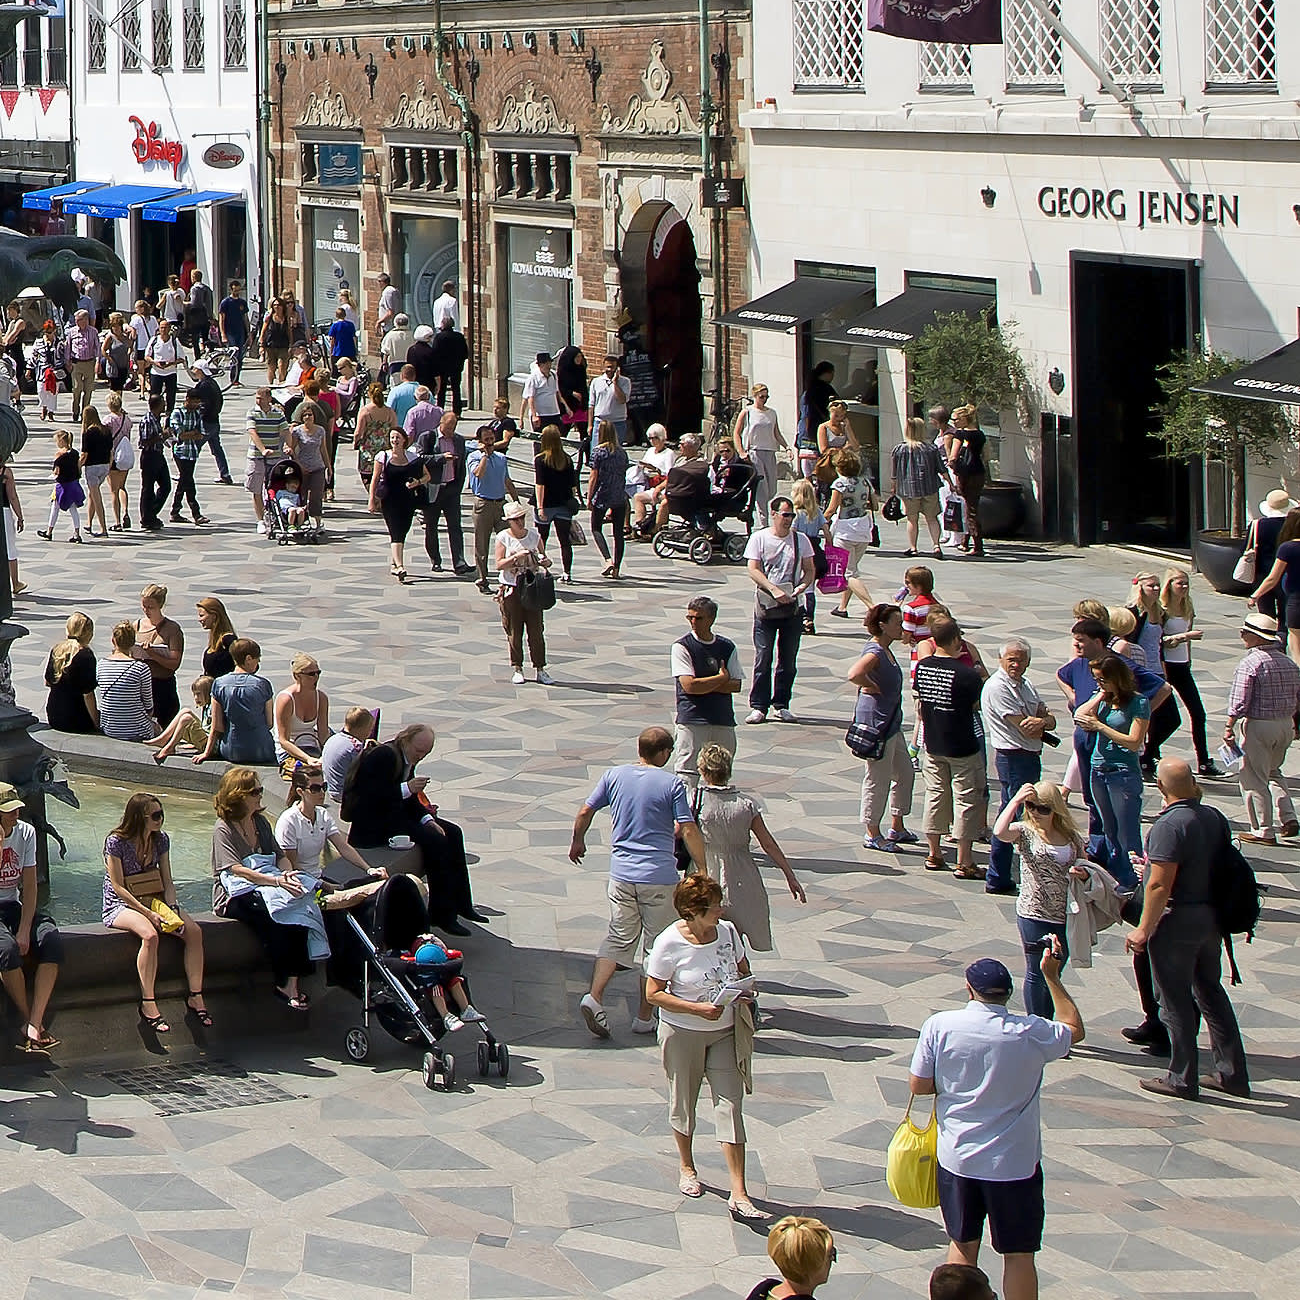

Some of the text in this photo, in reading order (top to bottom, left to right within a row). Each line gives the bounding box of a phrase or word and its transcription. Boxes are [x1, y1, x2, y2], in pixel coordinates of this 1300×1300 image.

[285, 29, 584, 56] ROYAL COPNHAGEN
[129, 115, 183, 181] Disney
[208, 151, 242, 165] Disney
[1037, 186, 1240, 231] GEORG JENSEN
[316, 239, 332, 250] ROYAL
[511, 262, 533, 275] ROYAL
[737, 310, 799, 325] GEORG JENSEN
[846, 327, 914, 342] GEORG JENSEN
[1233, 378, 1281, 390] GEORG
